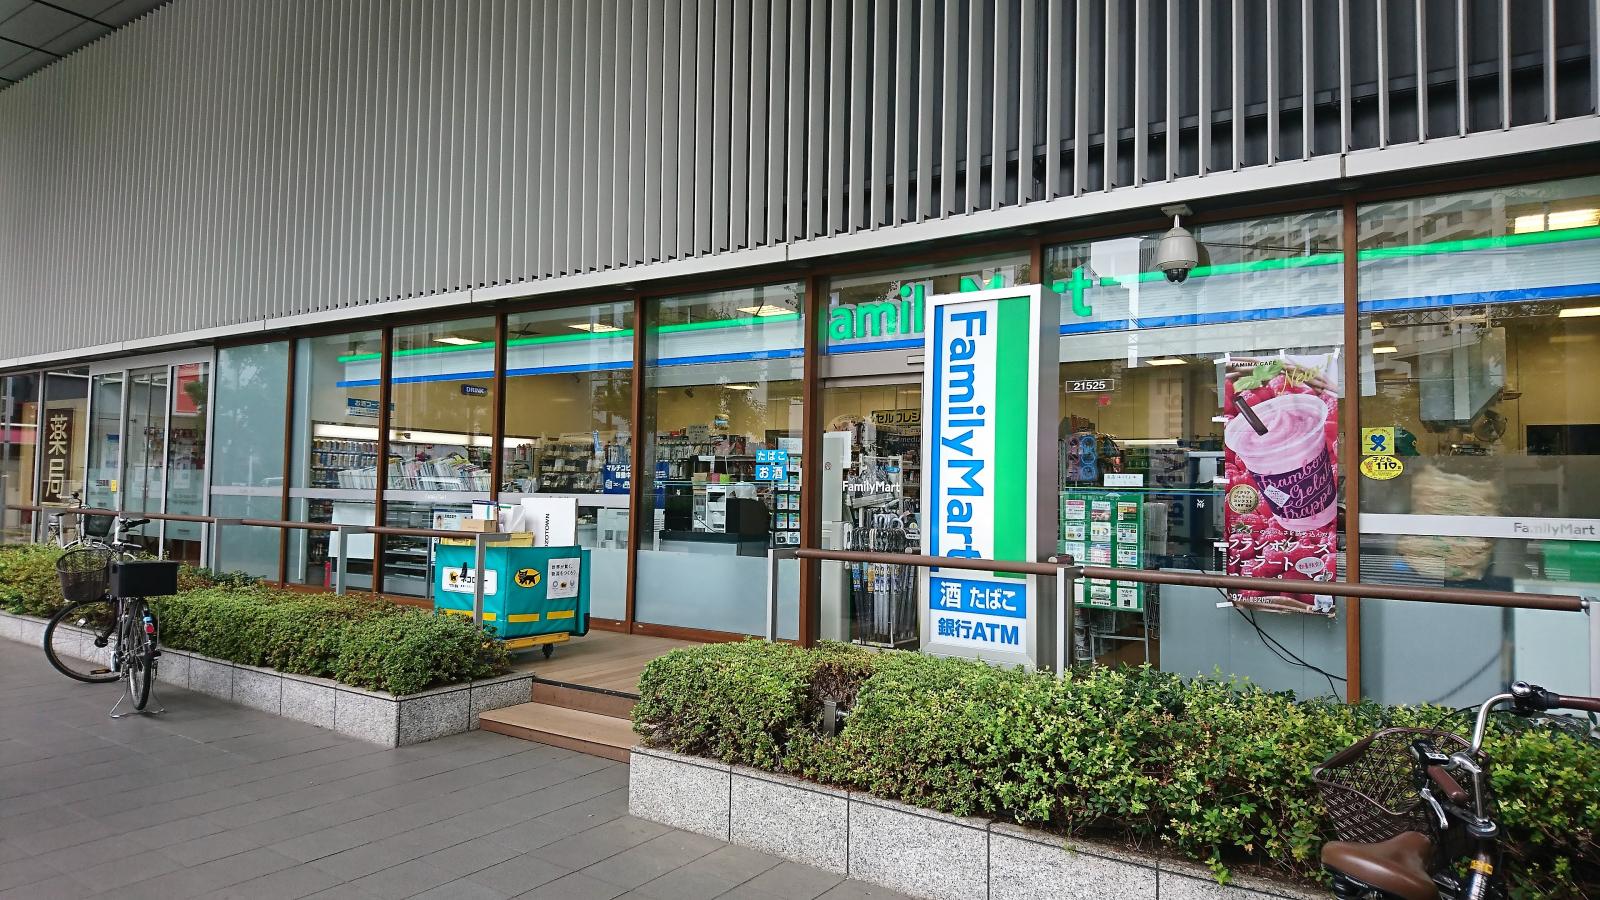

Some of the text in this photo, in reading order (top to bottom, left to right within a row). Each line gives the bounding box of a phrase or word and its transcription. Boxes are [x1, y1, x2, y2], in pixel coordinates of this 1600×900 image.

[1073, 381, 1106, 391] 21525
[941, 310, 987, 560] FamilyMart
[46, 413, 67, 497] 薬局
[758, 450, 785, 461] たばこ
[759, 466, 783, 479] お酒
[842, 481, 900, 494] FamilyMart
[1514, 523, 1595, 536] FamilyMart
[1229, 553, 1293, 572] ジェラート
[940, 582, 1017, 612] 酒 たばこ
[938, 617, 1019, 645] 銀行ATM
